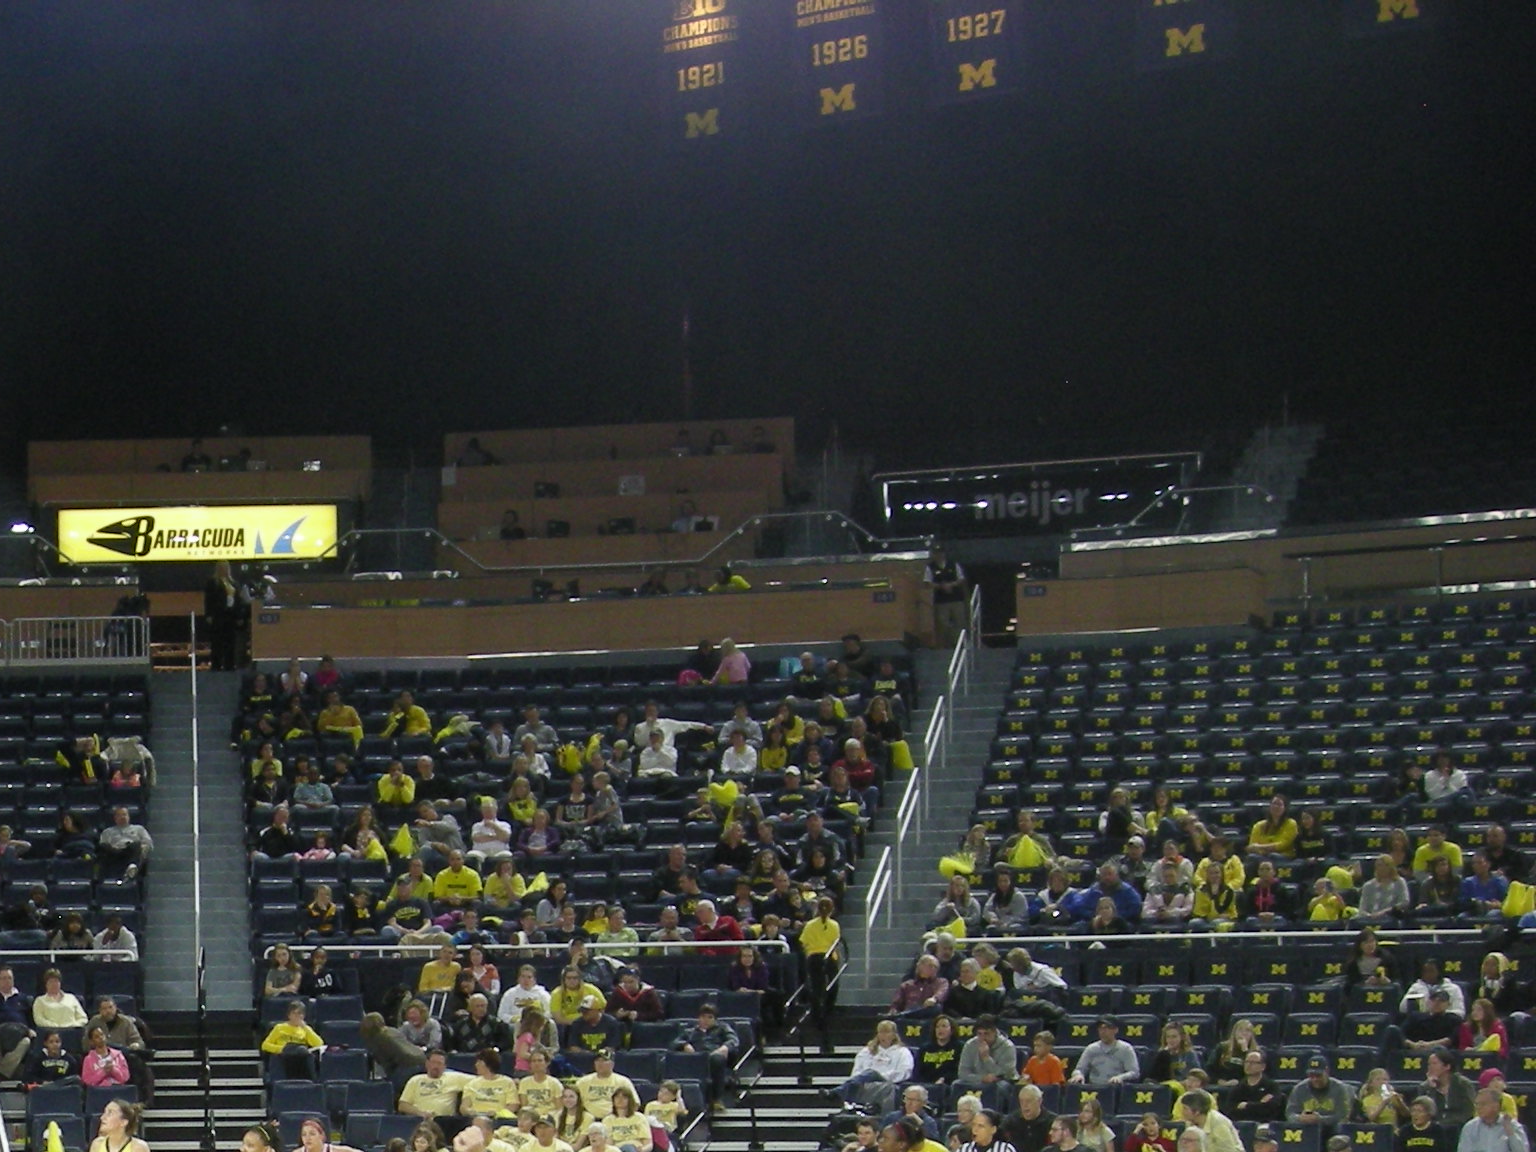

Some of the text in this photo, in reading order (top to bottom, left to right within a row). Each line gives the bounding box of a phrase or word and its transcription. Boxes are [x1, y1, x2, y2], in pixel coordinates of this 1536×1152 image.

[947, 10, 1007, 42] 1927
[1166, 24, 1205, 56] M
[812, 35, 868, 66] 1926
[677, 62, 724, 91] 1921
[959, 59, 997, 91] M
[820, 83, 856, 115] M
[685, 108, 719, 138] M
[974, 480, 1090, 524] meijer
